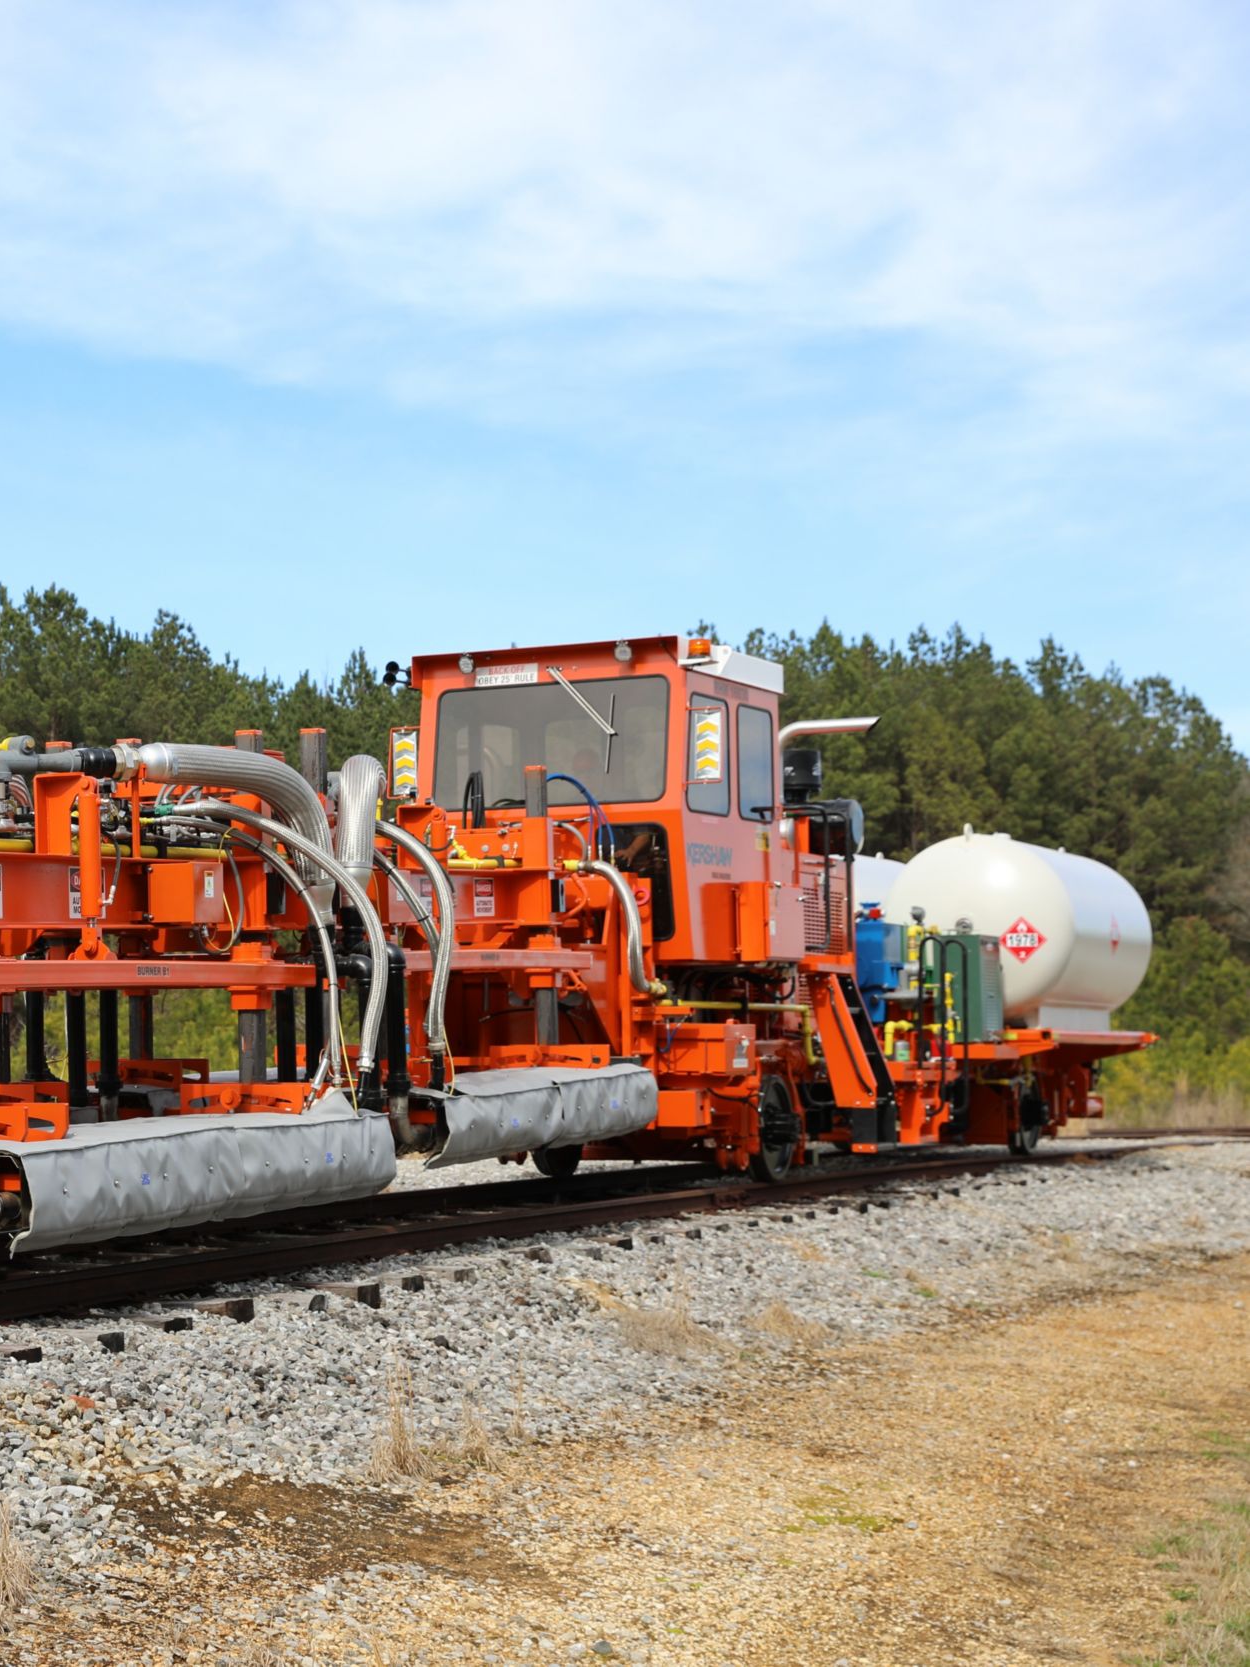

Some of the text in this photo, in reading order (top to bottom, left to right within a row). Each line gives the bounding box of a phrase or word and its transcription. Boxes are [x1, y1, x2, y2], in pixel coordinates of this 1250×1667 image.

[489, 664, 525, 675] BACK OFF
[478, 676, 499, 686] OBEY
[515, 672, 535, 683] RULE
[686, 842, 733, 868] KERSHAW
[1009, 933, 1036, 947] 1978
[137, 966, 161, 977] BURNER
